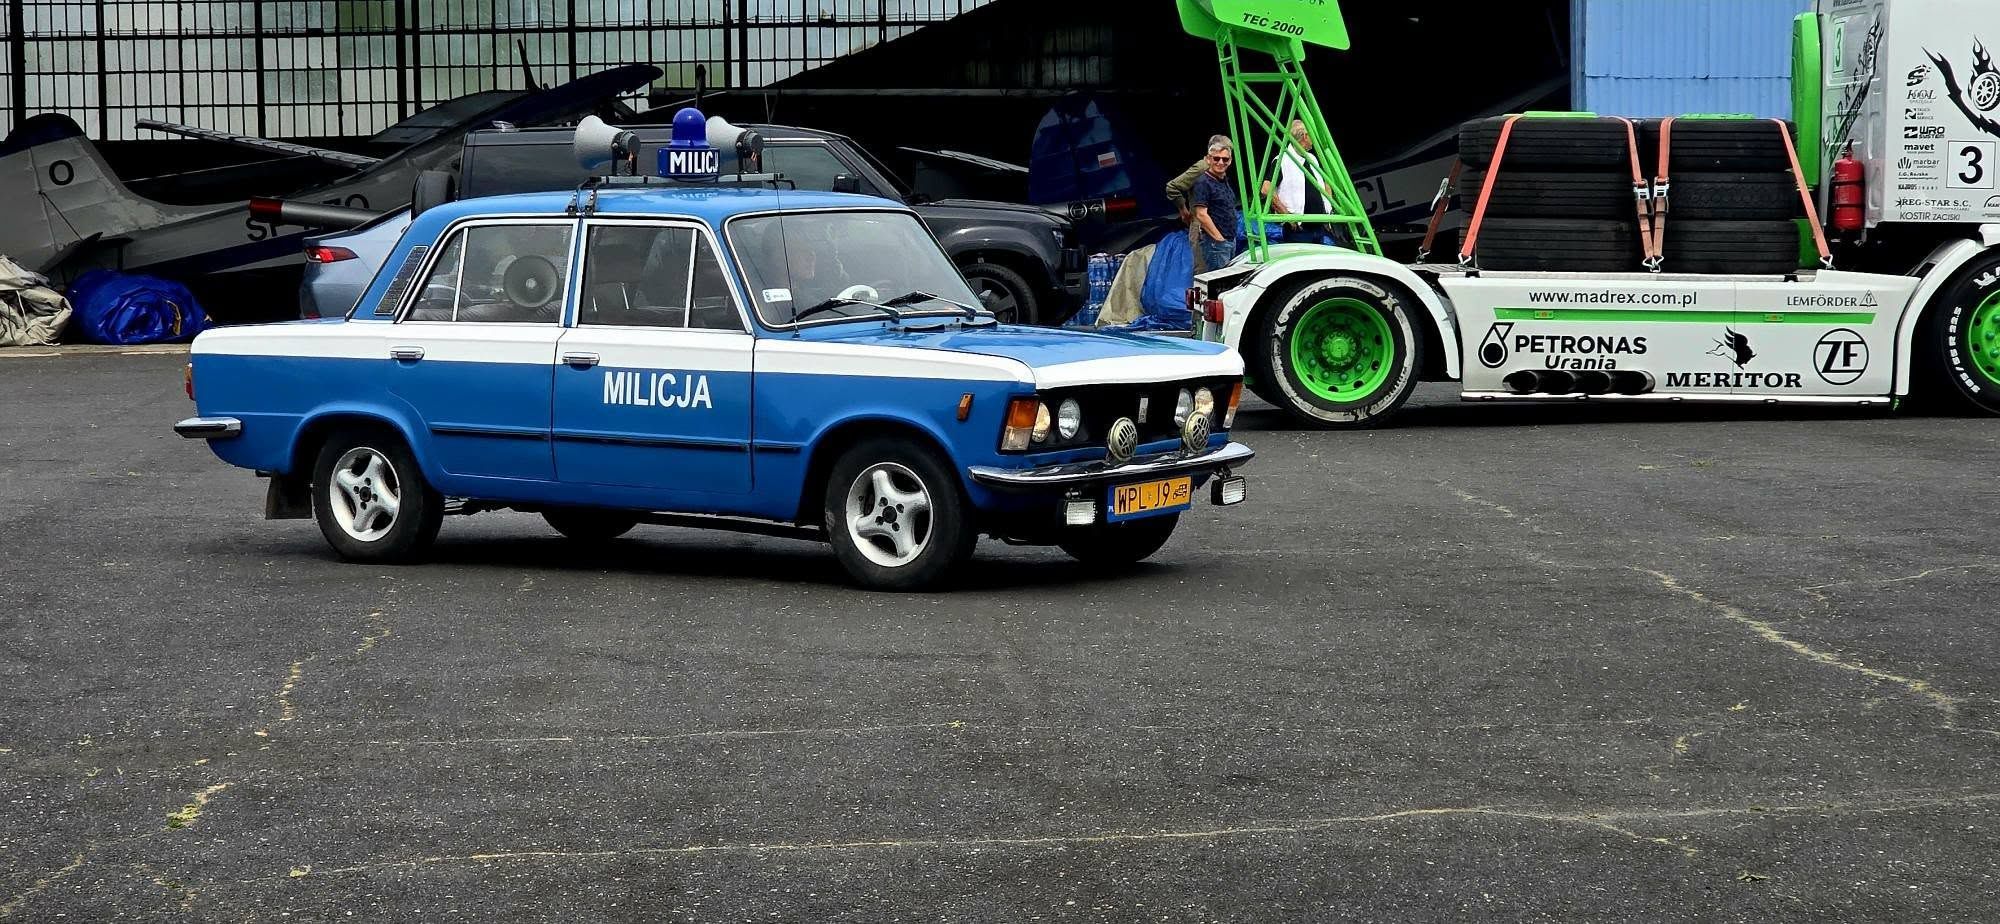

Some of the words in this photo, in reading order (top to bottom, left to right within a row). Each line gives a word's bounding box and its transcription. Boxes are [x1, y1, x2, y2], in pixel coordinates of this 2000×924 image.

[1242, 12, 1269, 27] TEC
[1270, 20, 1305, 36] 2000
[1835, 27, 1842, 67] 3
[1919, 126, 1945, 134] WRO
[1904, 143, 1935, 151] mavet
[1958, 145, 1984, 185] 3
[1900, 211, 1931, 220] KOSTIR
[1932, 213, 1961, 221] ZACISKI
[1528, 289, 1697, 308] www.madrex.com.pl
[1786, 294, 1858, 307] LEMFÖRDER
[1514, 335, 1648, 355] PETRONAS
[1545, 354, 1617, 370] Urania
[1817, 340, 1866, 374] ZF
[1665, 372, 1803, 388] MERITOR
[603, 371, 713, 409] MILICJA
[1117, 487, 1148, 514] WPL
[1153, 482, 1170, 508] J9
